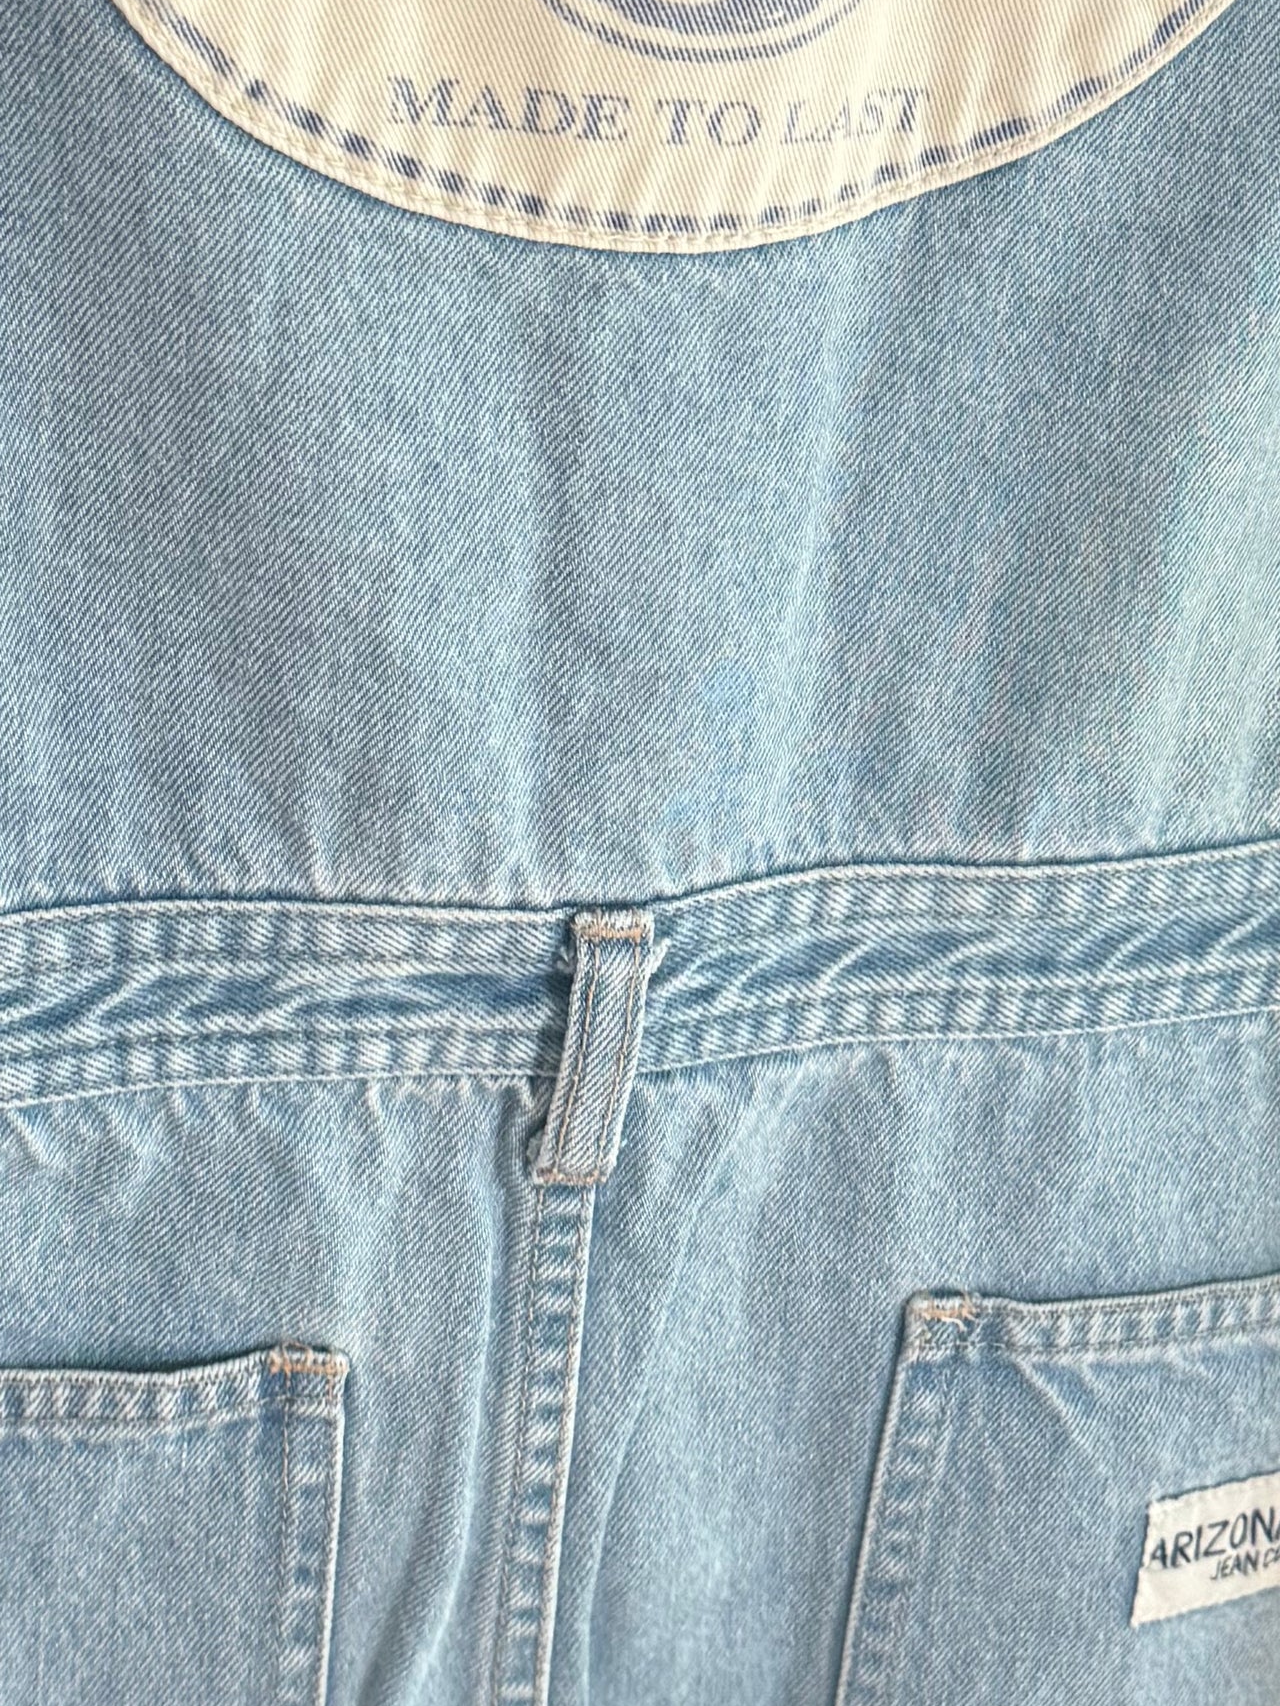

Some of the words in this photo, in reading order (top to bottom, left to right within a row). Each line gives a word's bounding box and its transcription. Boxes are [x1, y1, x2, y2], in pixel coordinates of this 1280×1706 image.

[388, 75, 632, 143] MADE
[656, 91, 767, 147] TO
[783, 88, 931, 146] LAST
[1210, 1549, 1259, 1580] JEAN
